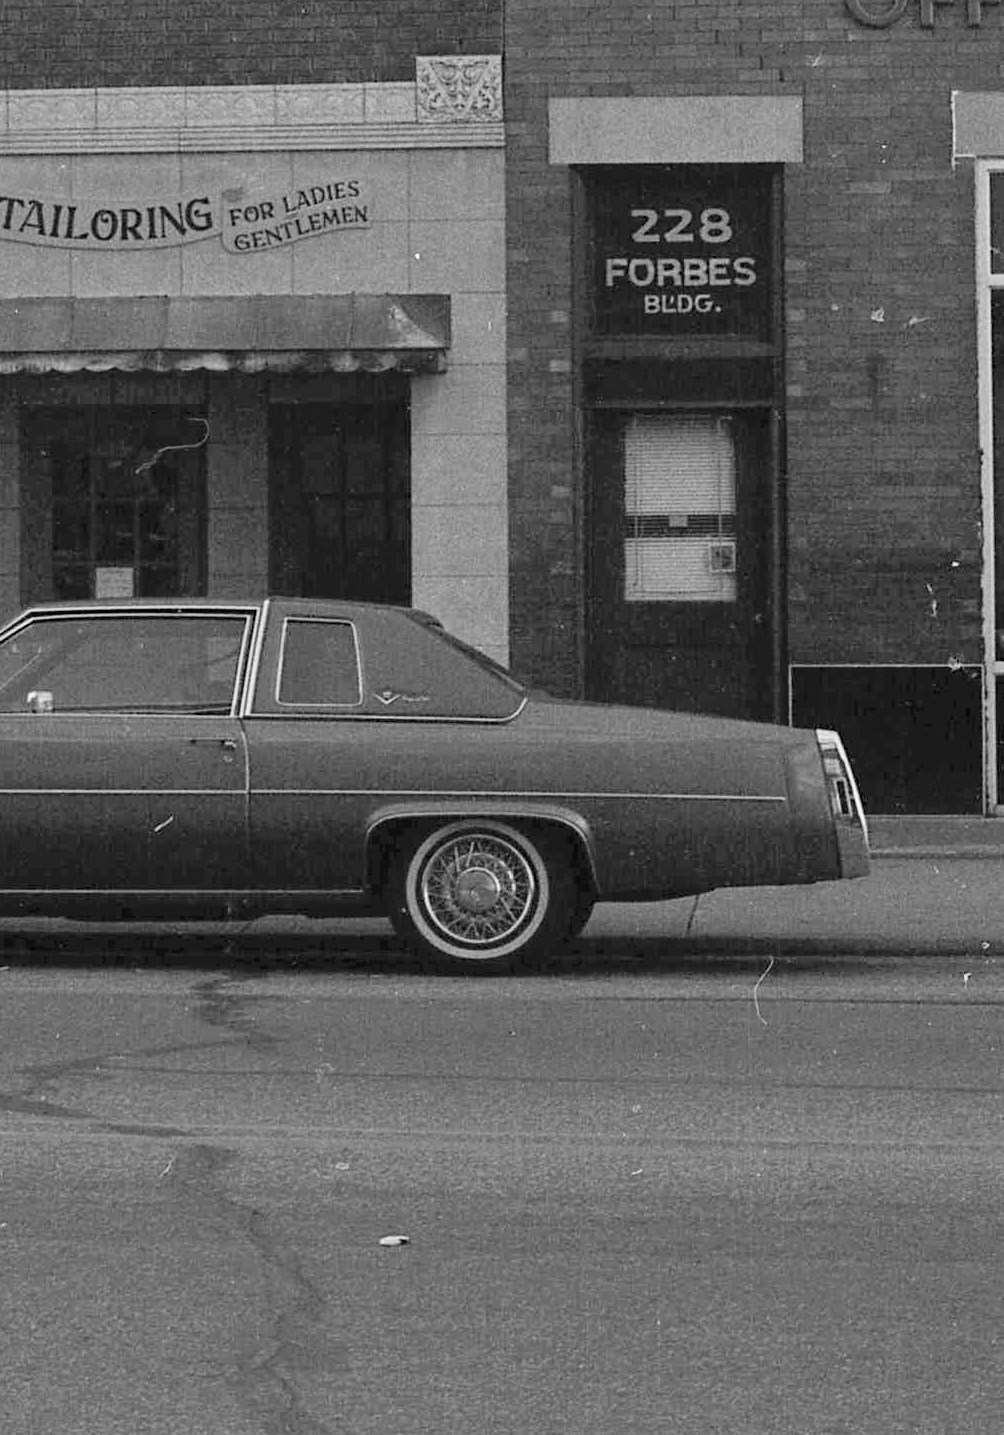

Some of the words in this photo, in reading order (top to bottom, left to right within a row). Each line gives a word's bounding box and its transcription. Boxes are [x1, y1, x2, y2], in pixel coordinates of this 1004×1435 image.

[230, 202, 274, 226] FOR
[283, 180, 360, 214] LADIES
[234, 206, 368, 251] GENTLEMEN
[631, 209, 733, 243] 228
[605, 258, 756, 286] FORBES
